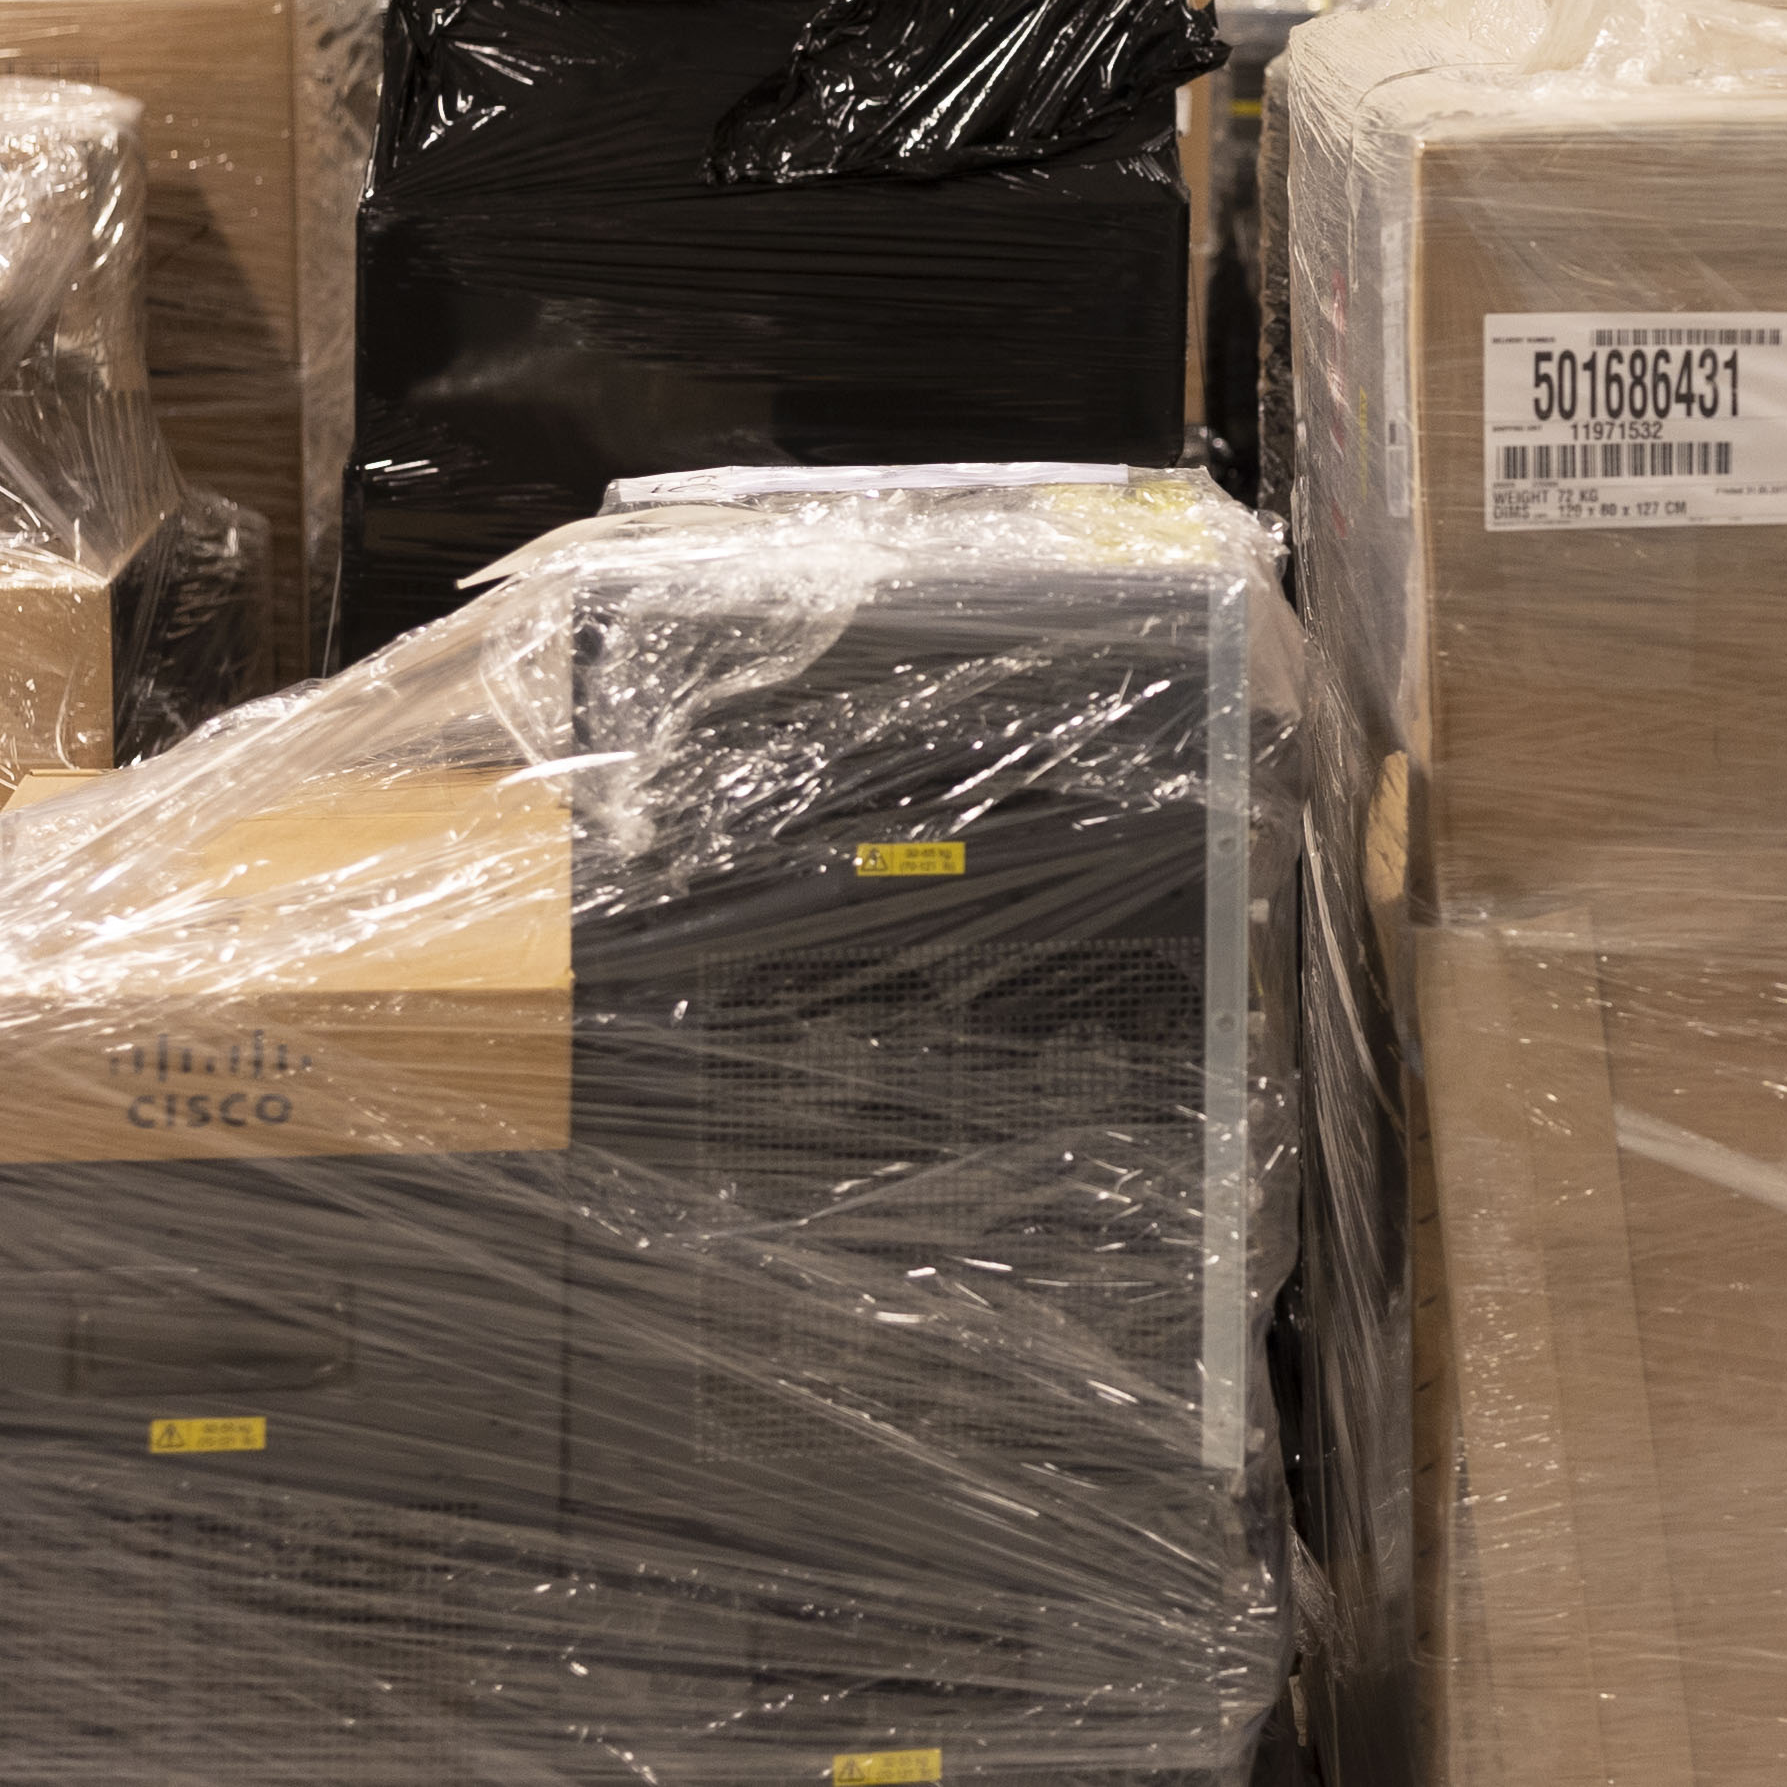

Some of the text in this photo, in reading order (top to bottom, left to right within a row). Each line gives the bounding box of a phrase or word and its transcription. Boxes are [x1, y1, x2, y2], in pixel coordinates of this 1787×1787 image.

[1533, 349, 1739, 420] 501686431
[1570, 421, 1664, 441] 11971532
[1493, 489, 1549, 504] WEIGHT
[1579, 487, 1599, 502] KG
[1665, 500, 1687, 515] CM
[127, 1093, 293, 1128] CISCO
